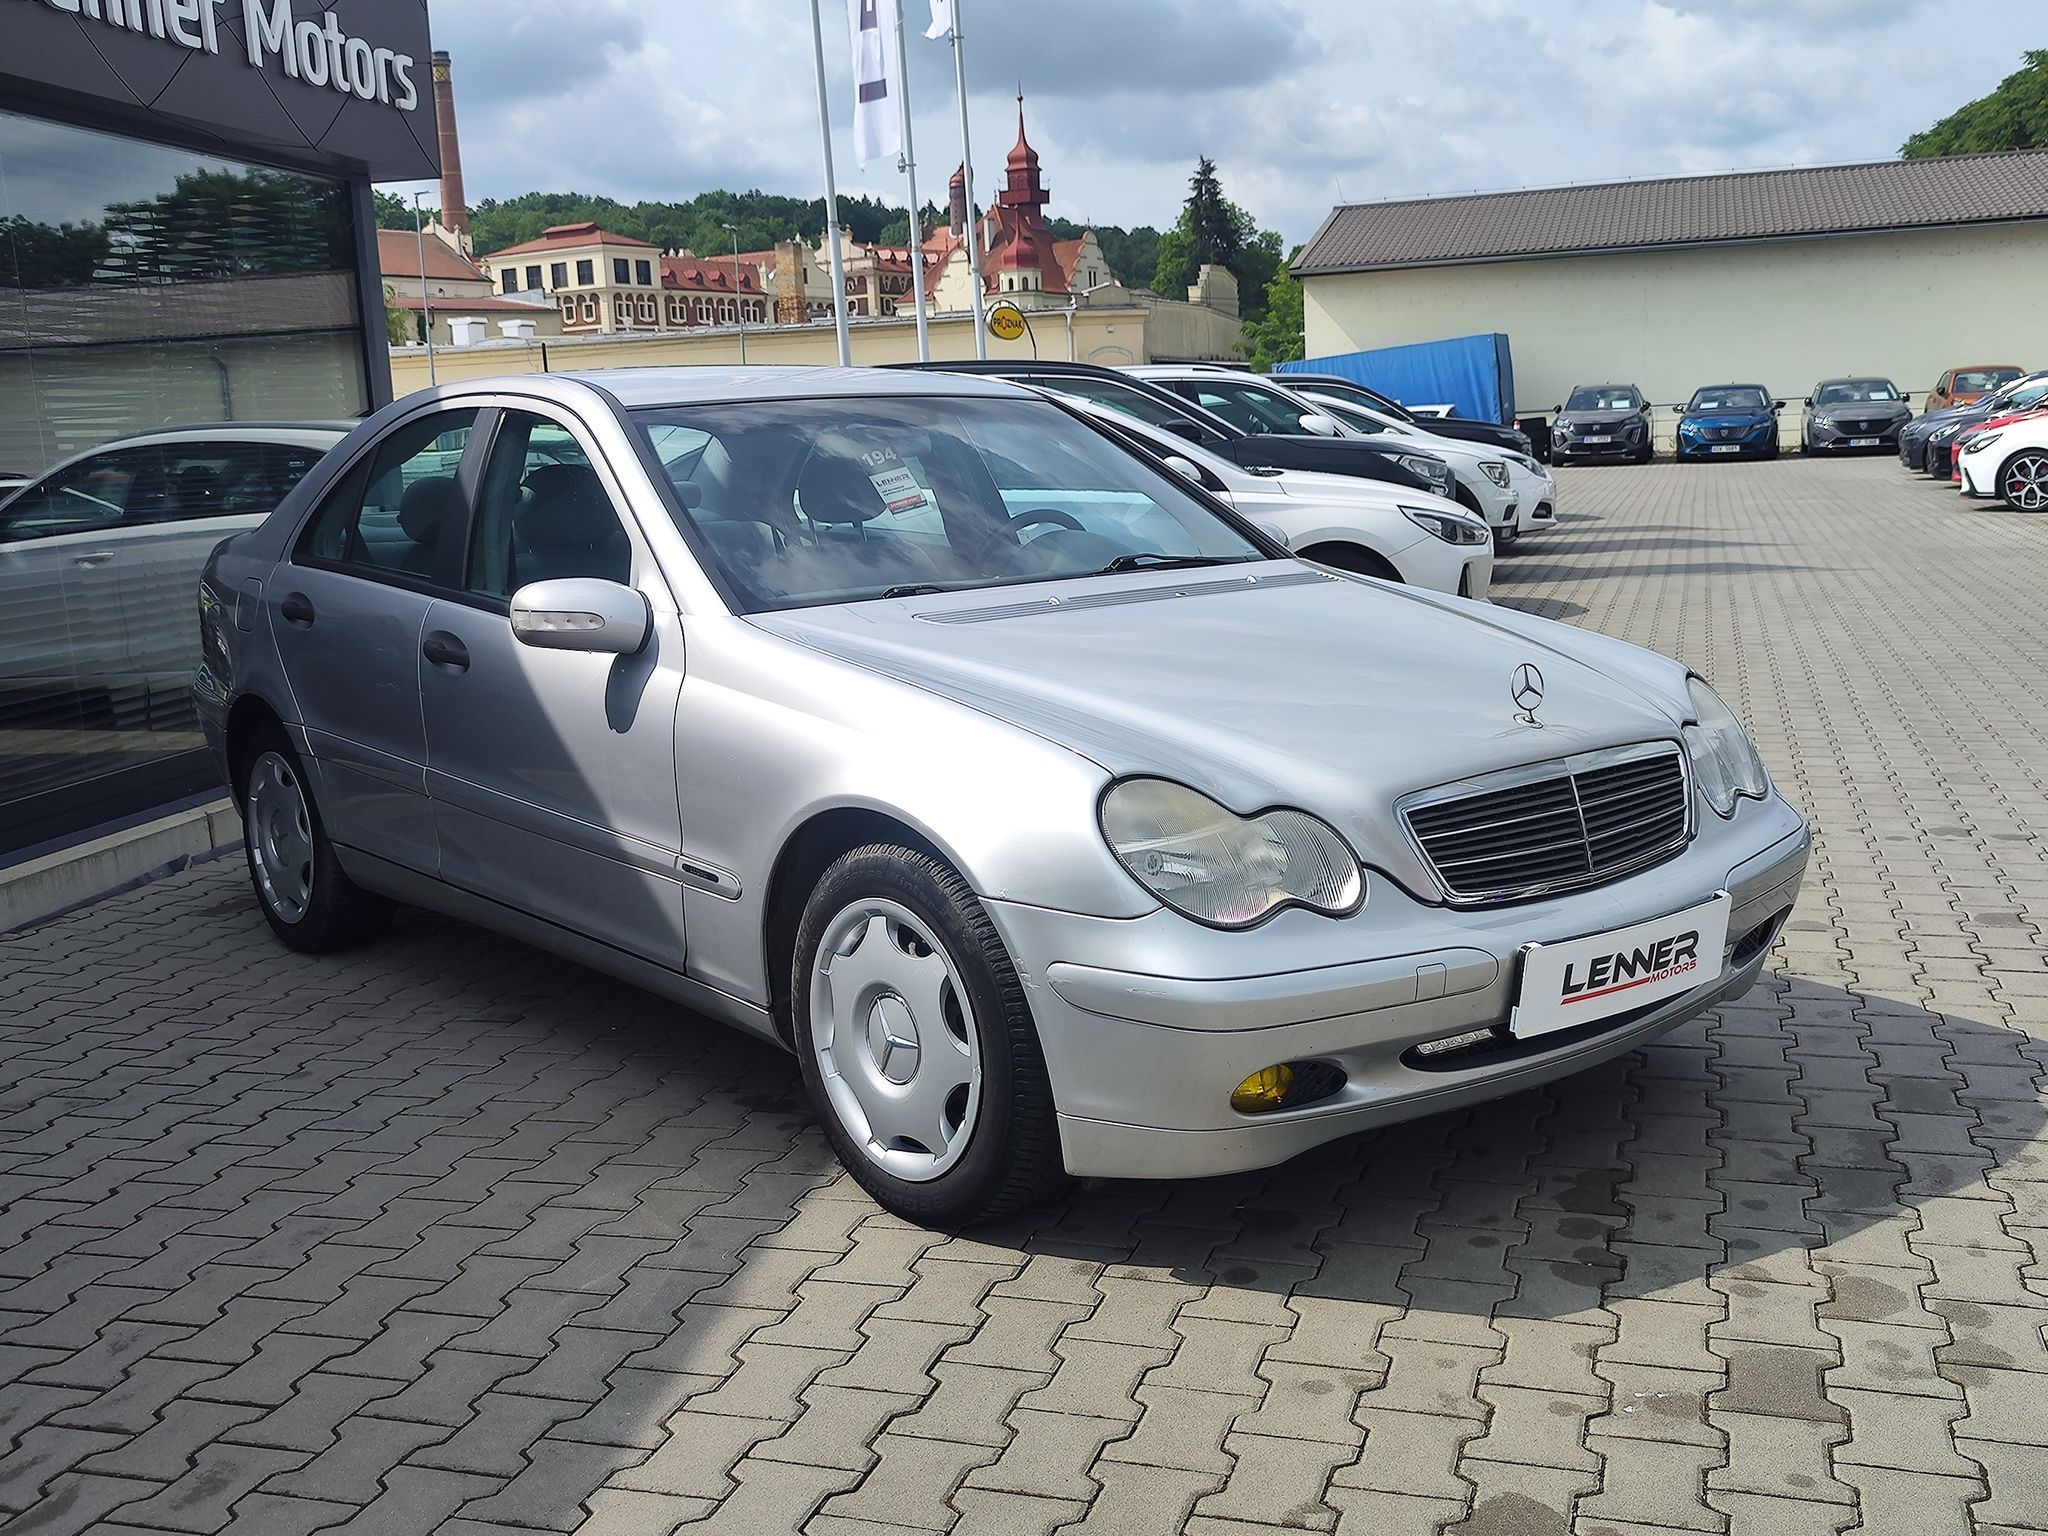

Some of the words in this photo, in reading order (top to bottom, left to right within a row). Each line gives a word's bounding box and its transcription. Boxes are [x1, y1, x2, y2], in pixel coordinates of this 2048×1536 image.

[246, 0, 418, 111] Motors
[861, 446, 897, 467] 194
[1561, 930, 1699, 996] LENNER
[1650, 958, 1698, 984] MOTORS
